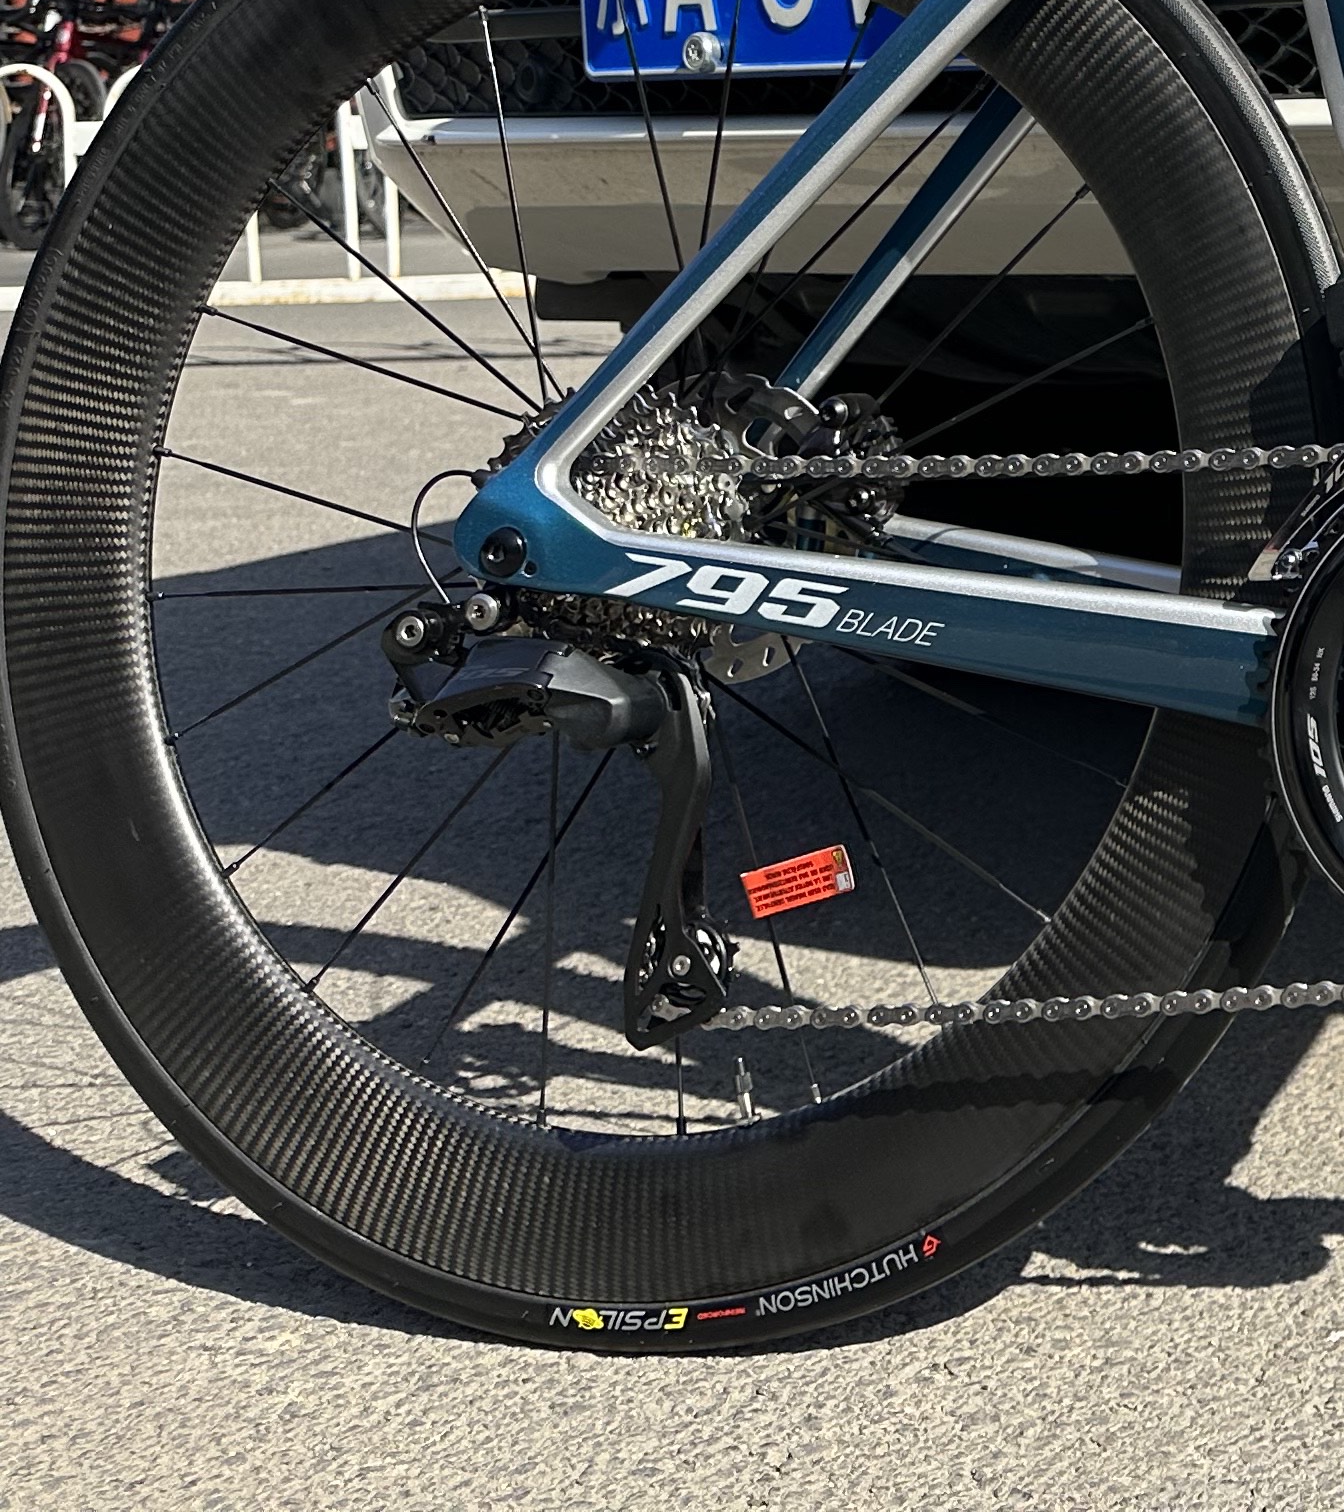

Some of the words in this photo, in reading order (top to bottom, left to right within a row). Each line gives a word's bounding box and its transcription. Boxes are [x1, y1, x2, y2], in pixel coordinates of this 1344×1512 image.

[603, 552, 850, 629] 795
[836, 609, 946, 648] BLADE
[1307, 713, 1327, 779] 105
[758, 1244, 919, 1316] HUTCHINSON
